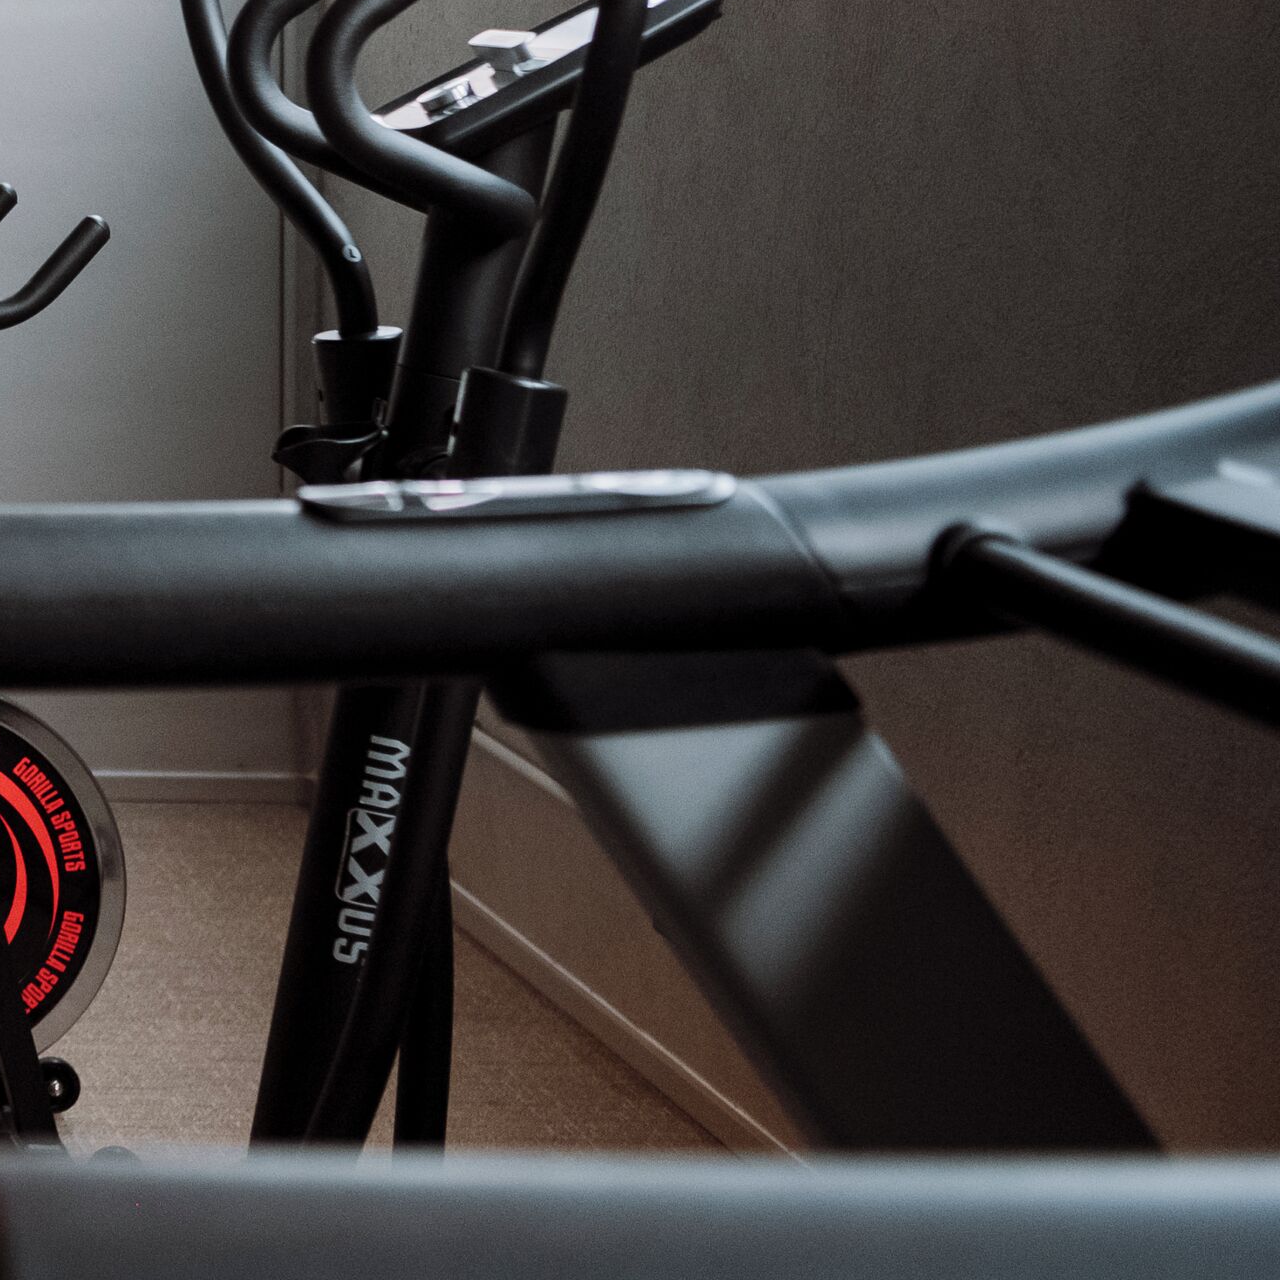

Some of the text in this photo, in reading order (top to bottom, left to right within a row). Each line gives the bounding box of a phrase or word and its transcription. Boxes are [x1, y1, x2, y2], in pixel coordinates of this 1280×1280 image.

[12, 756, 87, 872] GORILLA SPORTS
[332, 735, 412, 966] MAXXUS
[49, 910, 84, 973] GORILLA
